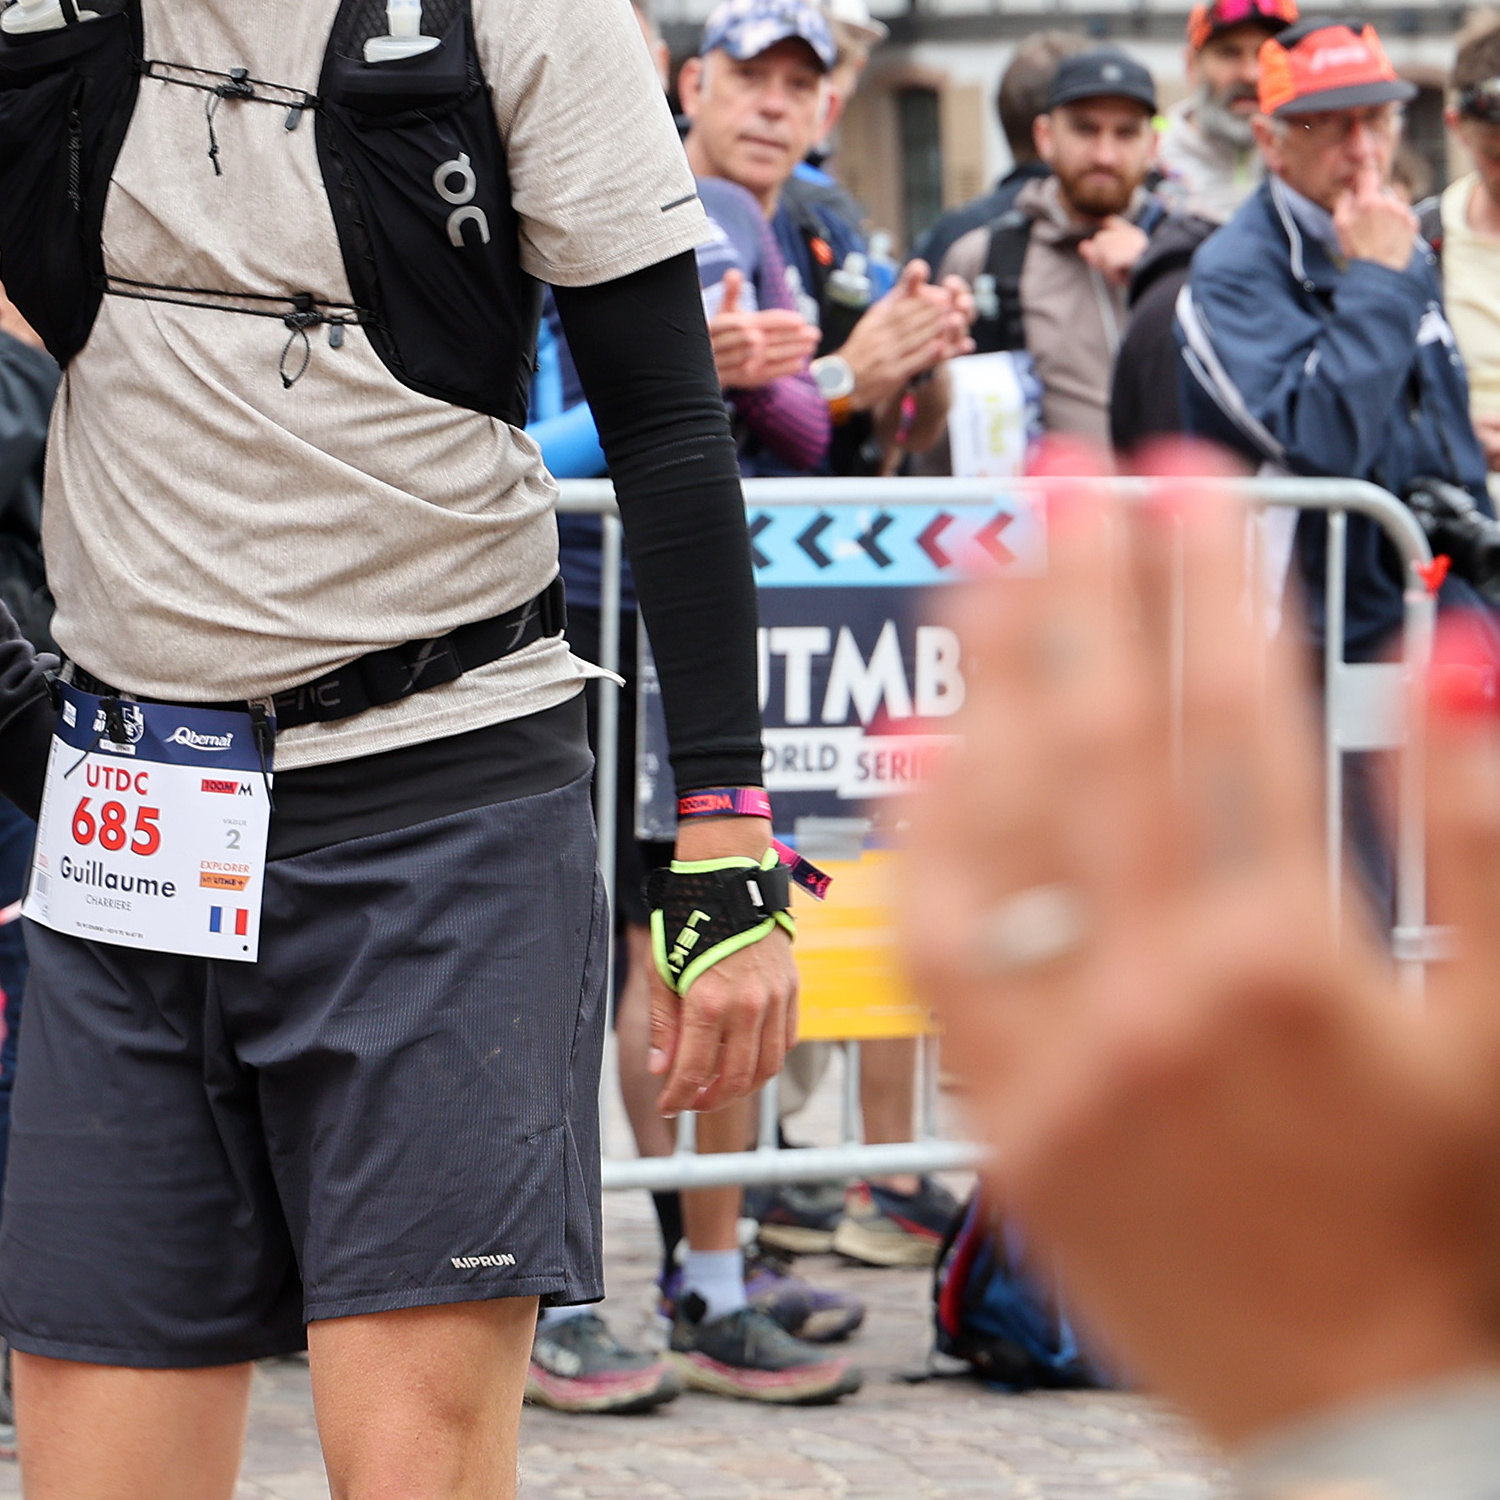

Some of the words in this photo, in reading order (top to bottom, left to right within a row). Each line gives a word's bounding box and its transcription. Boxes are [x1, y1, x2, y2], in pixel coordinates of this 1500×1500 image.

[763, 744, 839, 774] ORLD
[86, 763, 149, 795] UTDC
[237, 783, 253, 797] M
[71, 796, 161, 857] 685
[226, 828, 241, 850] 2
[61, 855, 177, 898] Guillaume
[200, 860, 250, 873] EXPLORER
[85, 894, 132, 912] CHARRIERE
[666, 909, 712, 974] LEKI
[450, 1253, 516, 1269] KIPRUN
